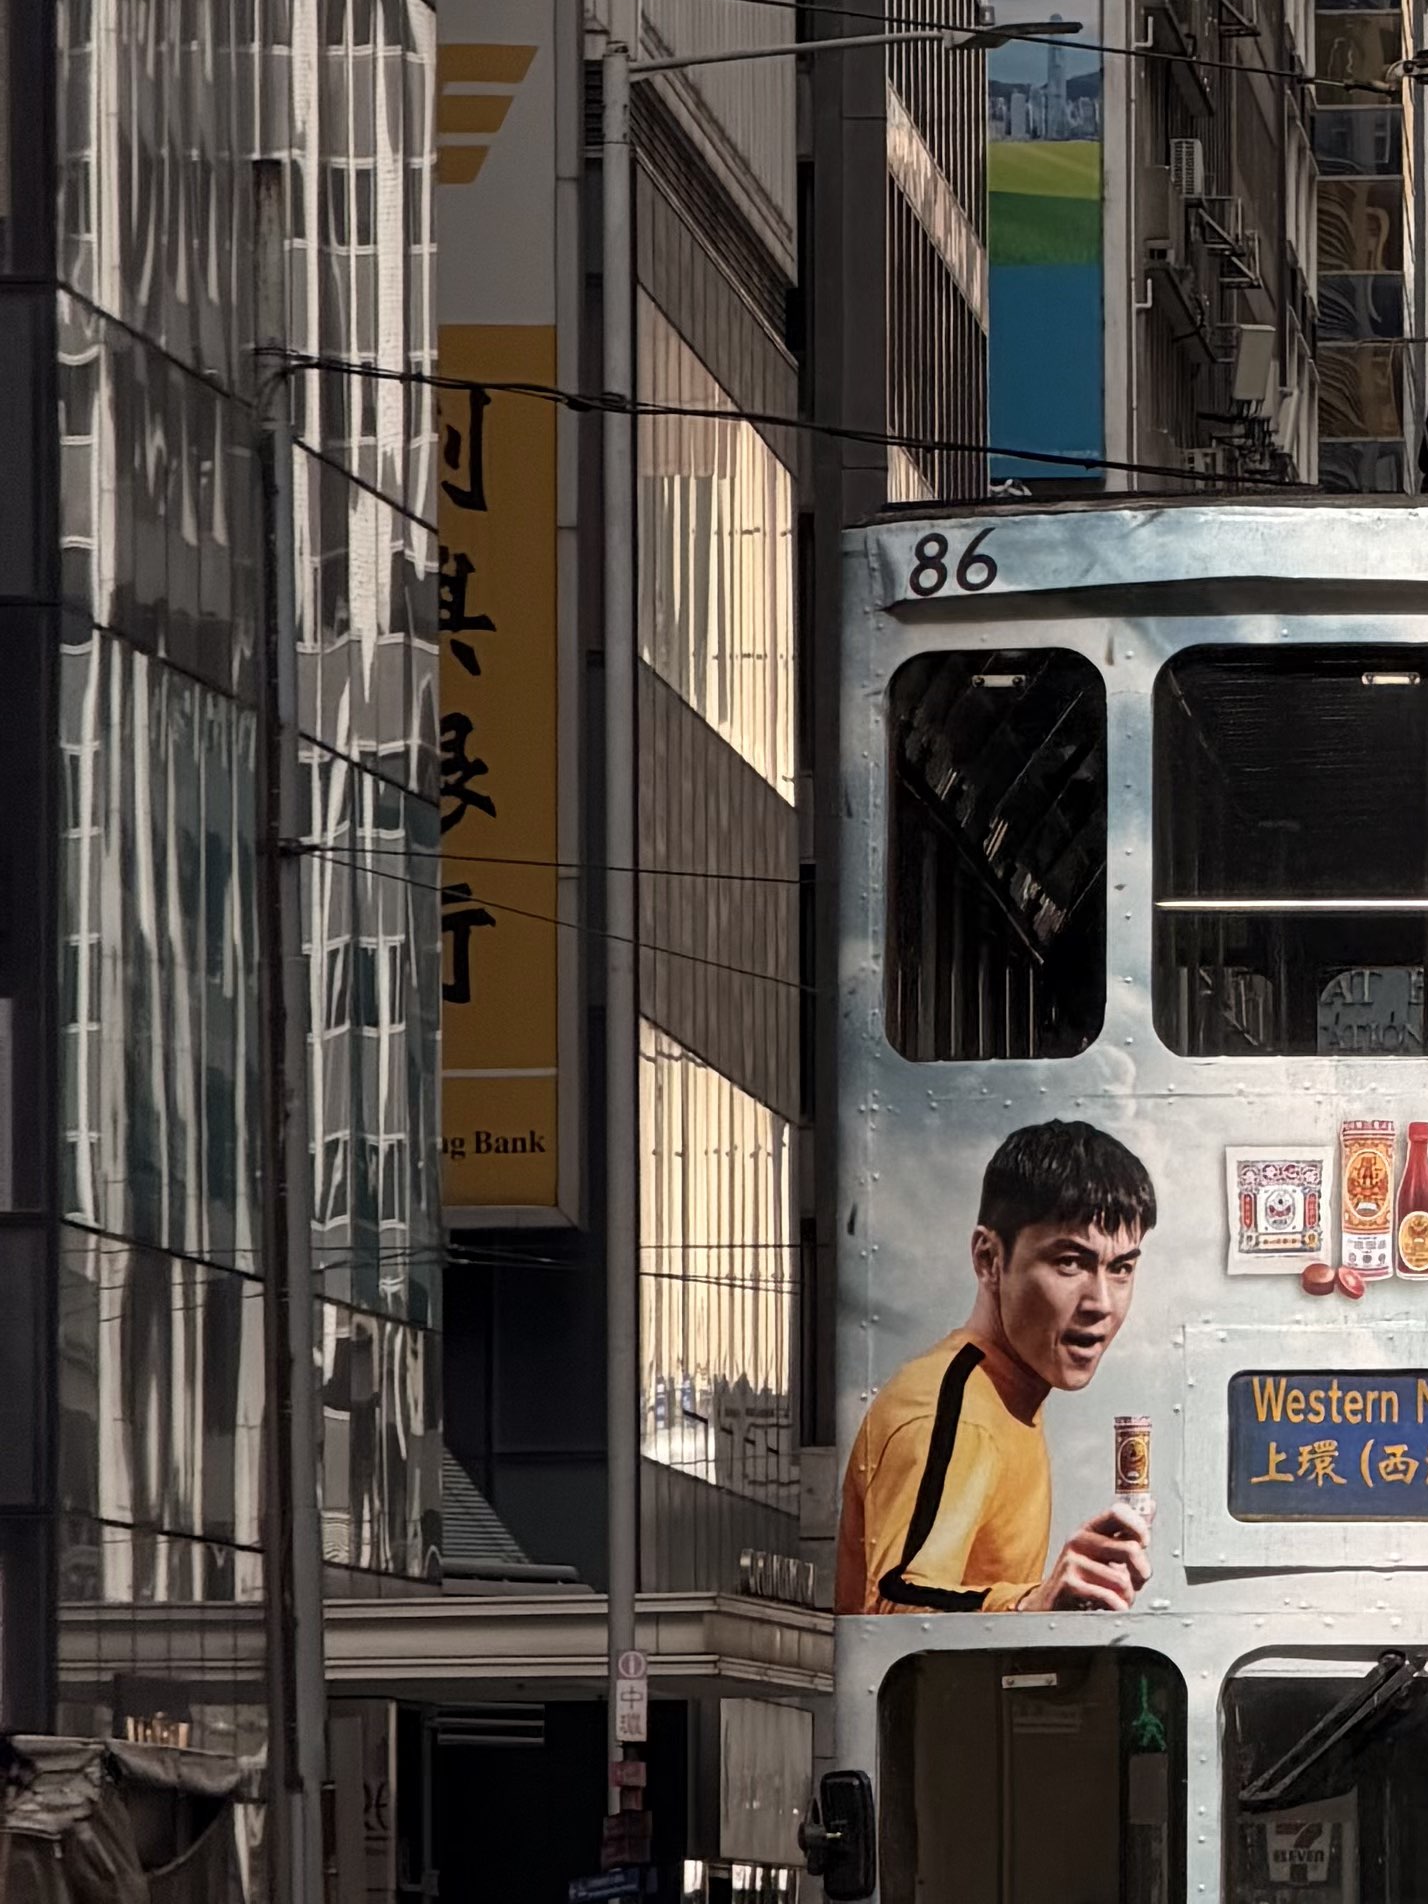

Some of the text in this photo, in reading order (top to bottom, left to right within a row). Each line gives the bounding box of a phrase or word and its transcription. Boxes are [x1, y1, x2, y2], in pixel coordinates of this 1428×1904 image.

[909, 528, 998, 597] 86
[474, 1130, 546, 1155] Bank
[1253, 1375, 1399, 1424] Western
